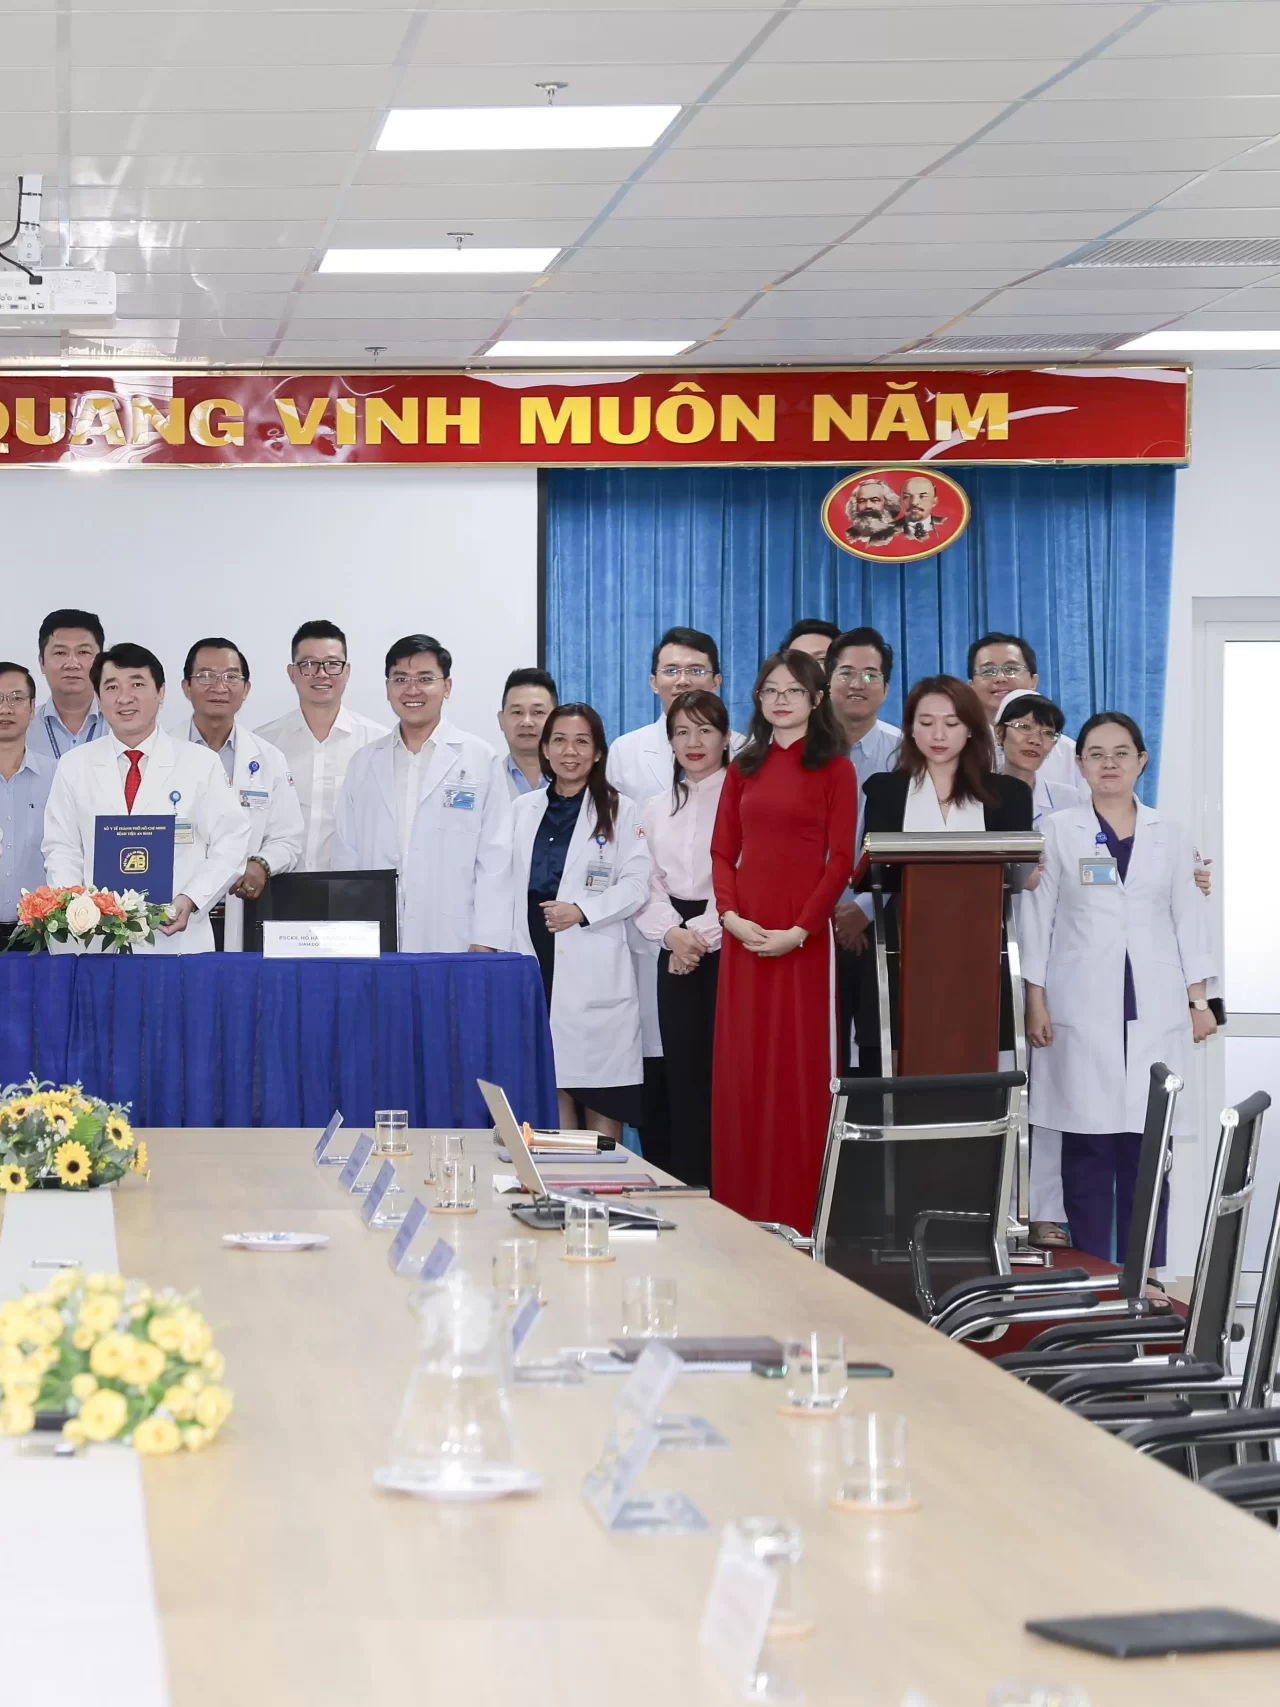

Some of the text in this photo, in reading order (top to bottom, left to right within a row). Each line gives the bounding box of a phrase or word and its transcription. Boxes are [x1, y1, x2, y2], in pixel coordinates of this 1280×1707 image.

[277, 398, 481, 445] VINH
[520, 382, 775, 444] MUÔN
[813, 381, 1009, 441] NĂM
